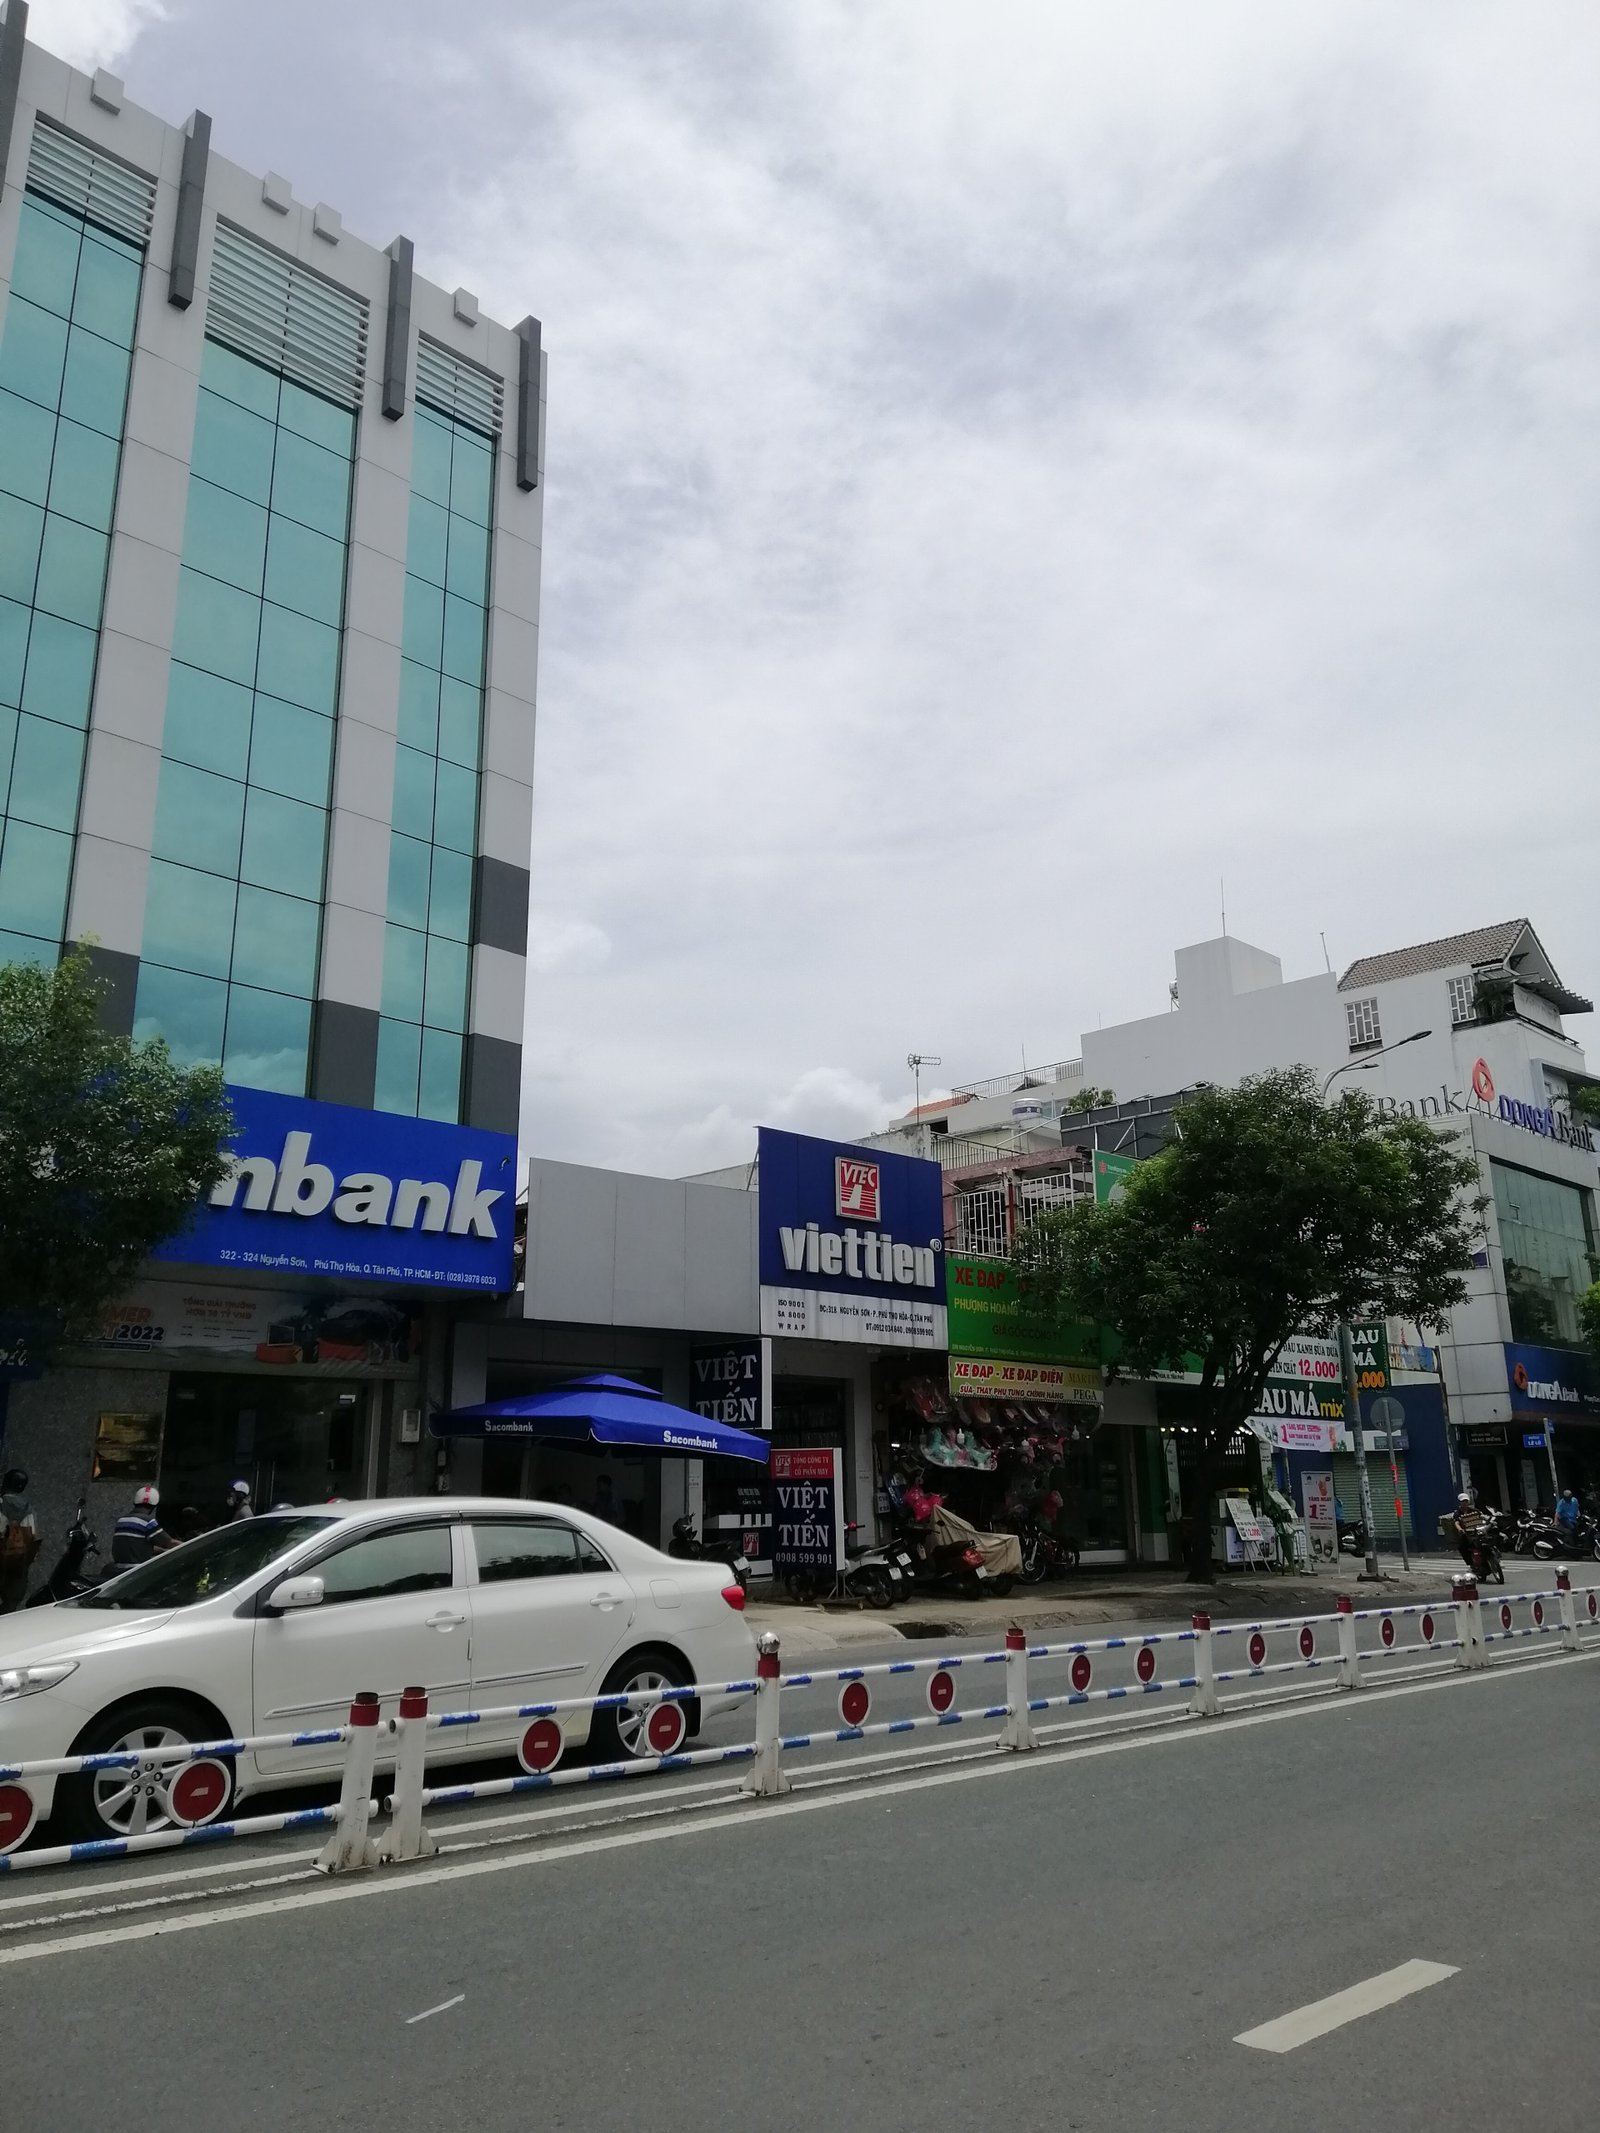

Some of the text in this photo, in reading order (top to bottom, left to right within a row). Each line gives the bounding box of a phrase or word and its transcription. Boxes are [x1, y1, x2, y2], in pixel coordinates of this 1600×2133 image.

[1382, 1084, 1470, 1124] Bank
[842, 1162, 877, 1188] VTEC
[220, 1250, 236, 1261] 322
[243, 1252, 258, 1262] 324
[314, 1259, 328, 1270] Phú
[330, 1260, 344, 1272] Thọ
[373, 1264, 385, 1275] Tân
[480, 1275, 496, 1285] 6033
[955, 1266, 973, 1287] XE
[788, 1300, 805, 1308] 9001
[118, 1324, 164, 1341] 2022
[694, 1349, 757, 1386] VIỆT
[955, 1363, 969, 1377] XE
[971, 1364, 994, 1381] ĐẠP
[1002, 1366, 1015, 1380] XE
[1017, 1368, 1038, 1384] ĐẠP
[1039, 1367, 1064, 1387] ĐIỆN
[1354, 1371, 1386, 1388] .000
[696, 1386, 757, 1422] TIẾN
[1073, 1388, 1097, 1401] PEGA
[1254, 1382, 1344, 1418] AU MÁ mix
[485, 1420, 533, 1432] Sacombank
[663, 1430, 718, 1449] Sacombank
[776, 1480, 829, 1514] VIỆT
[778, 1514, 829, 1547] TIẾN
[776, 1552, 832, 1565] 0908 599 901
